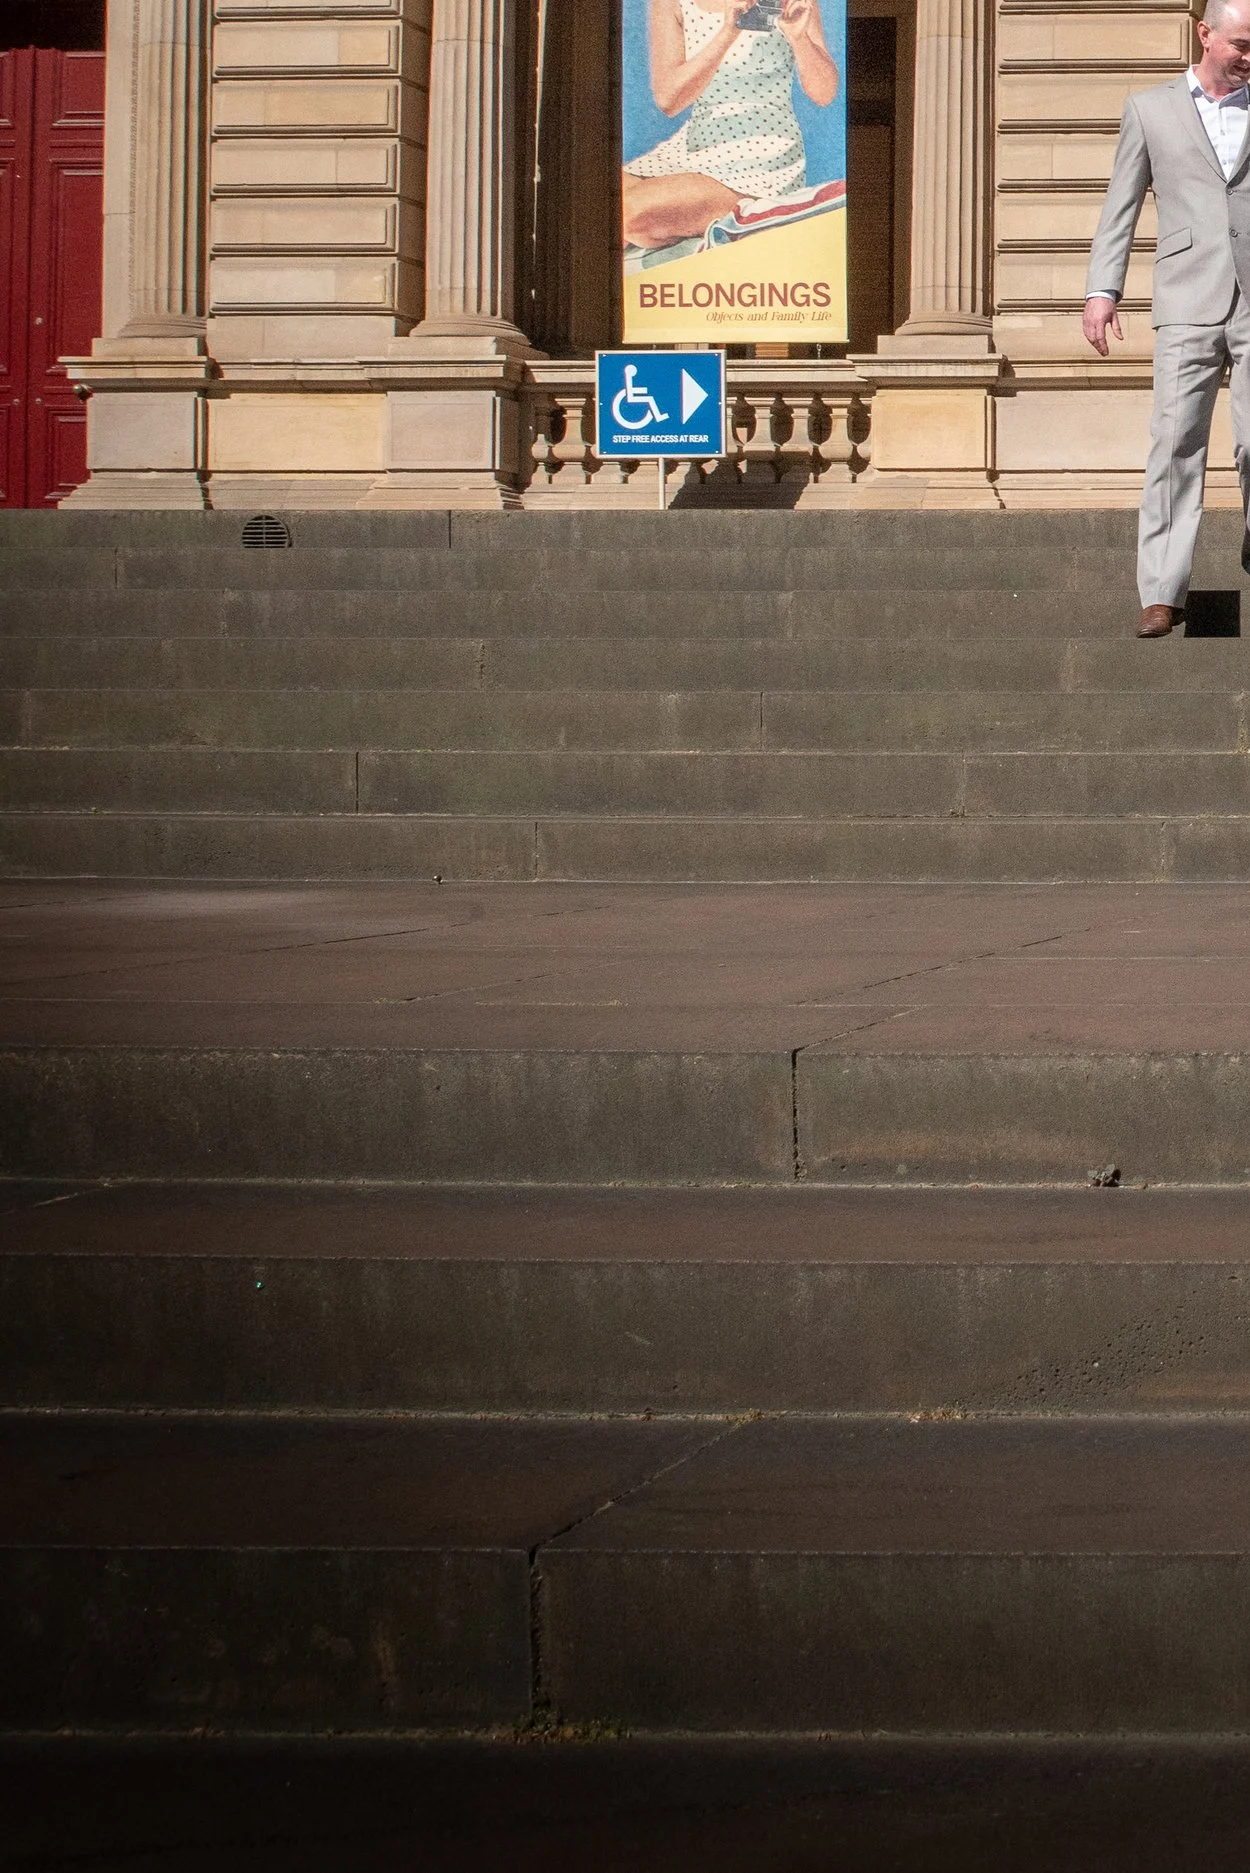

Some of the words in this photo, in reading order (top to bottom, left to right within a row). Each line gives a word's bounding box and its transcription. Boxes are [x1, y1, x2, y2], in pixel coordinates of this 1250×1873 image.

[639, 282, 832, 308] BELONGINGS
[706, 311, 744, 324] Objects
[746, 311, 768, 322] and
[771, 311, 809, 323] Family
[811, 311, 832, 321] Life
[612, 434, 632, 443] STEP
[631, 434, 650, 443] FREE
[650, 434, 679, 443] ACCESS
[679, 434, 688, 443] AT
[688, 434, 709, 443] REAR
